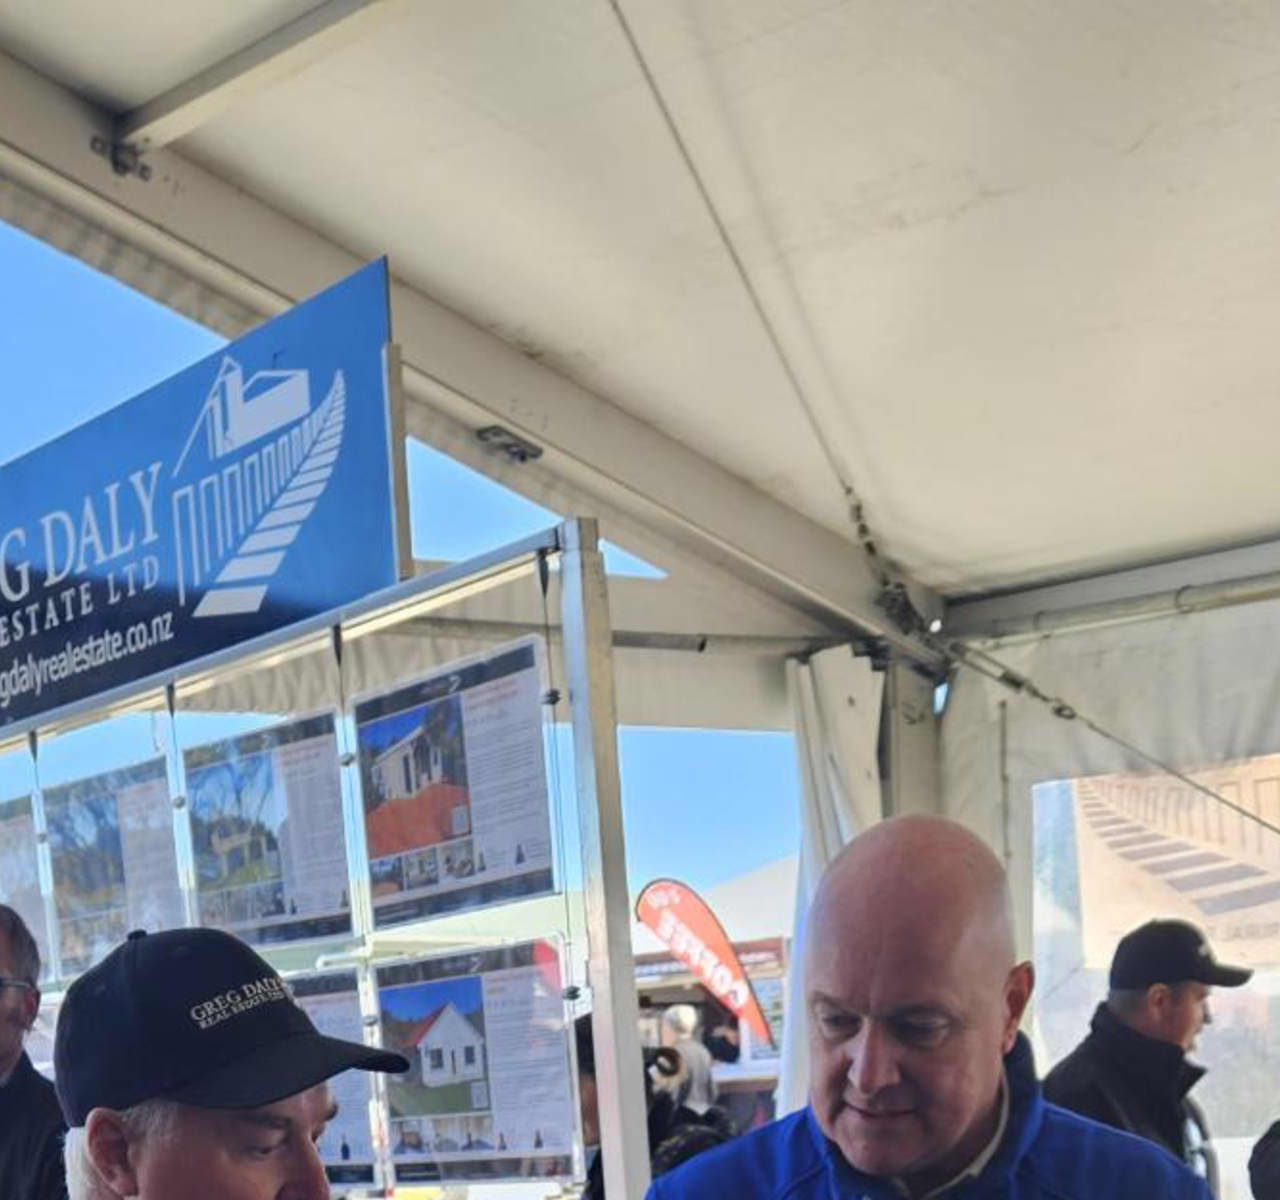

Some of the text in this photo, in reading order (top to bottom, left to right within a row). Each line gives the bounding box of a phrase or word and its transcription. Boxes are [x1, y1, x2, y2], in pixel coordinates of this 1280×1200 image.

[40, 461, 162, 587] DALY
[107, 554, 160, 605] LTD
[190, 990, 241, 1020] GREG
